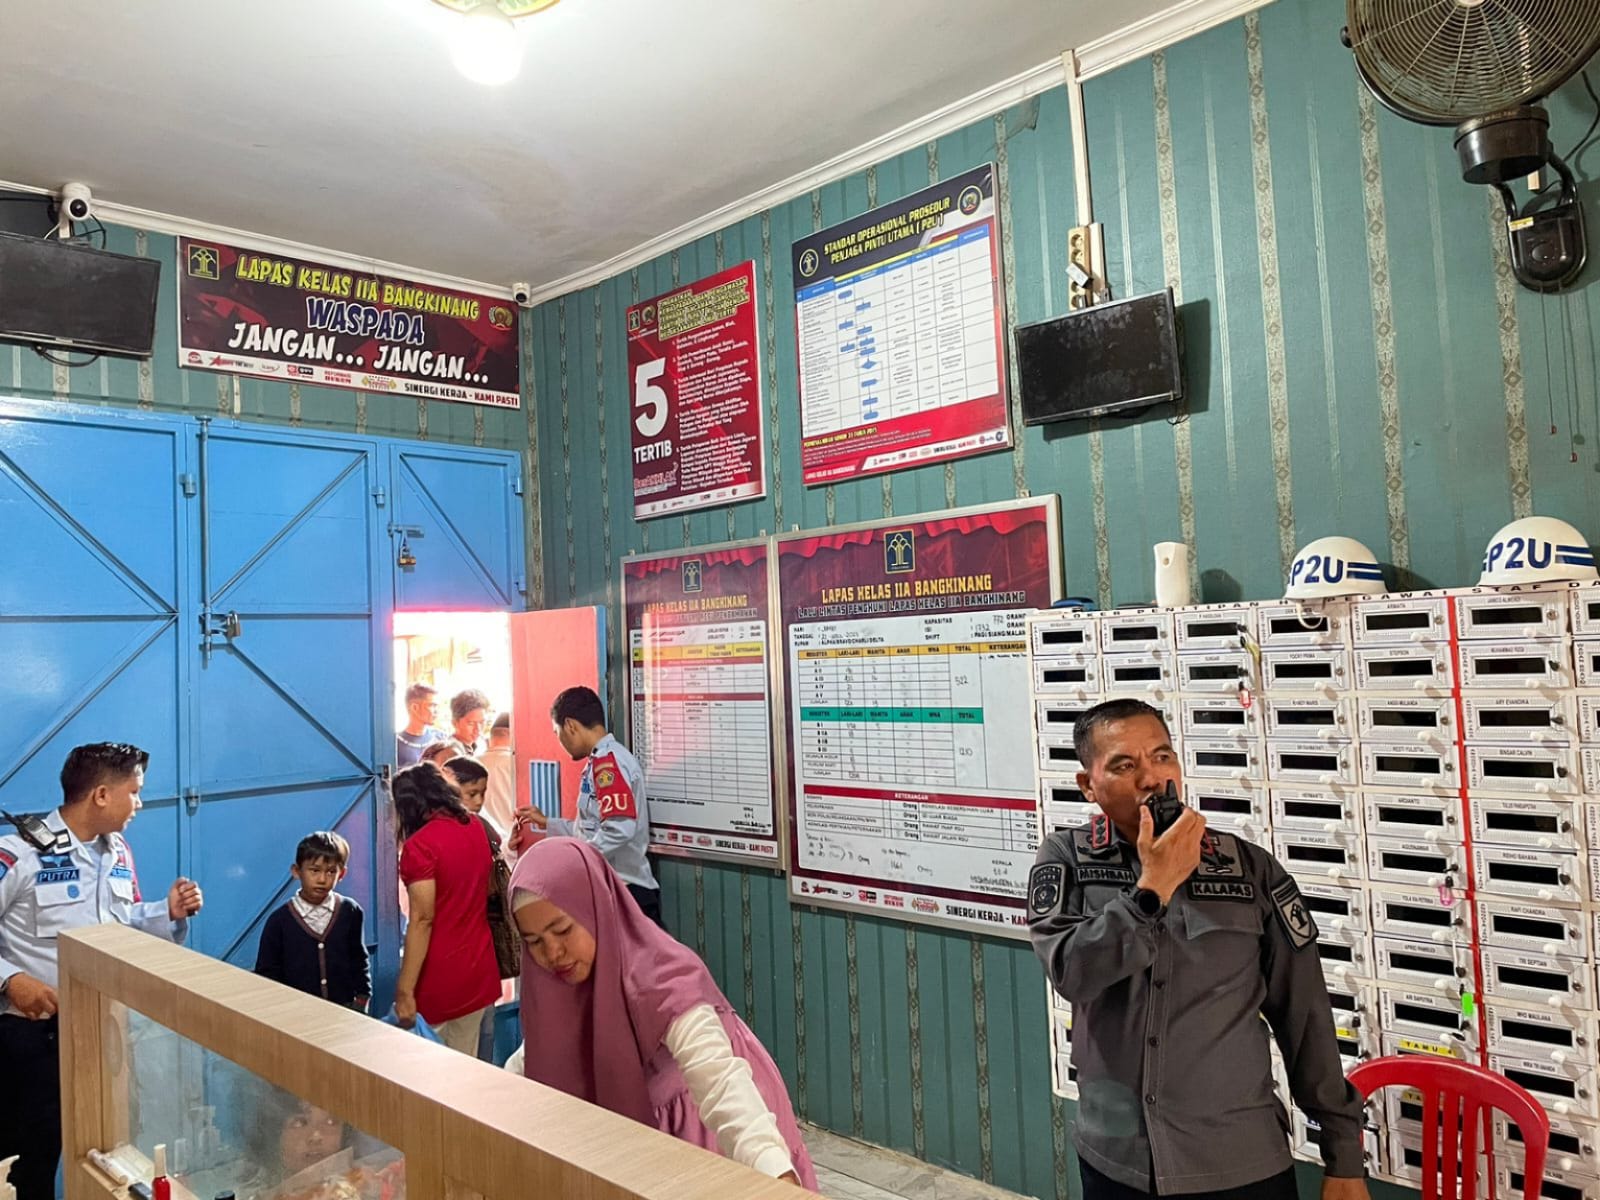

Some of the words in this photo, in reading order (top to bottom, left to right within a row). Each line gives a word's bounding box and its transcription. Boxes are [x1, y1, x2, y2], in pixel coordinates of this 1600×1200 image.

[824, 234, 856, 255] STANDAR
[857, 214, 907, 241] OPERASIONAL
[908, 197, 951, 221] PROSEDUR
[831, 244, 863, 264] PENJAGA
[864, 235, 887, 252] PINTU
[887, 224, 914, 242] UTAMA
[921, 215, 938, 230] P2U
[236, 254, 294, 287] LAPAS
[299, 266, 351, 300] KELAS
[357, 278, 380, 302] IIA
[383, 283, 480, 320] BANGKINANG
[306, 297, 424, 345] WASPADA
[228, 323, 364, 366] JANGAN...
[374, 345, 488, 384] JANGAN...
[405, 383, 439, 395] SINERGI
[440, 386, 467, 398] KERJA
[474, 393, 495, 402] KAMI
[496, 395, 518, 406] PASTI
[635, 357, 669, 439] 5
[634, 440, 673, 464] TERTIB
[1487, 537, 1552, 573] P2U
[1291, 555, 1344, 586] P2U
[822, 587, 854, 604] LAPAS
[857, 583, 891, 600] KELAS
[895, 580, 911, 598] IIA
[914, 574, 992, 597] BANGKINANG
[666, 600, 688, 612] KELAS
[690, 599, 699, 610] IIA
[701, 594, 748, 610] BANGKINANG
[818, 604, 847, 617] LINTAS
[847, 600, 888, 615] PENGHUNI
[889, 599, 917, 611] LAPAS
[918, 597, 945, 609] KELAS
[947, 595, 961, 608] IIA
[963, 591, 1025, 606] BANGKINANG
[924, 617, 952, 625] KAPASITAS
[903, 802, 917, 810] Orang
[903, 812, 918, 820] Orang
[904, 822, 918, 830] Orang
[904, 831, 919, 840] Orang
[39, 870, 78, 881] PUTRA
[1079, 868, 1132, 882] MISHBAH
[1193, 883, 1251, 898] KALAPAS
[946, 905, 976, 919] SINERGI
[978, 909, 1004, 923] KERJA
[1406, 1042, 1438, 1052] TAMU
